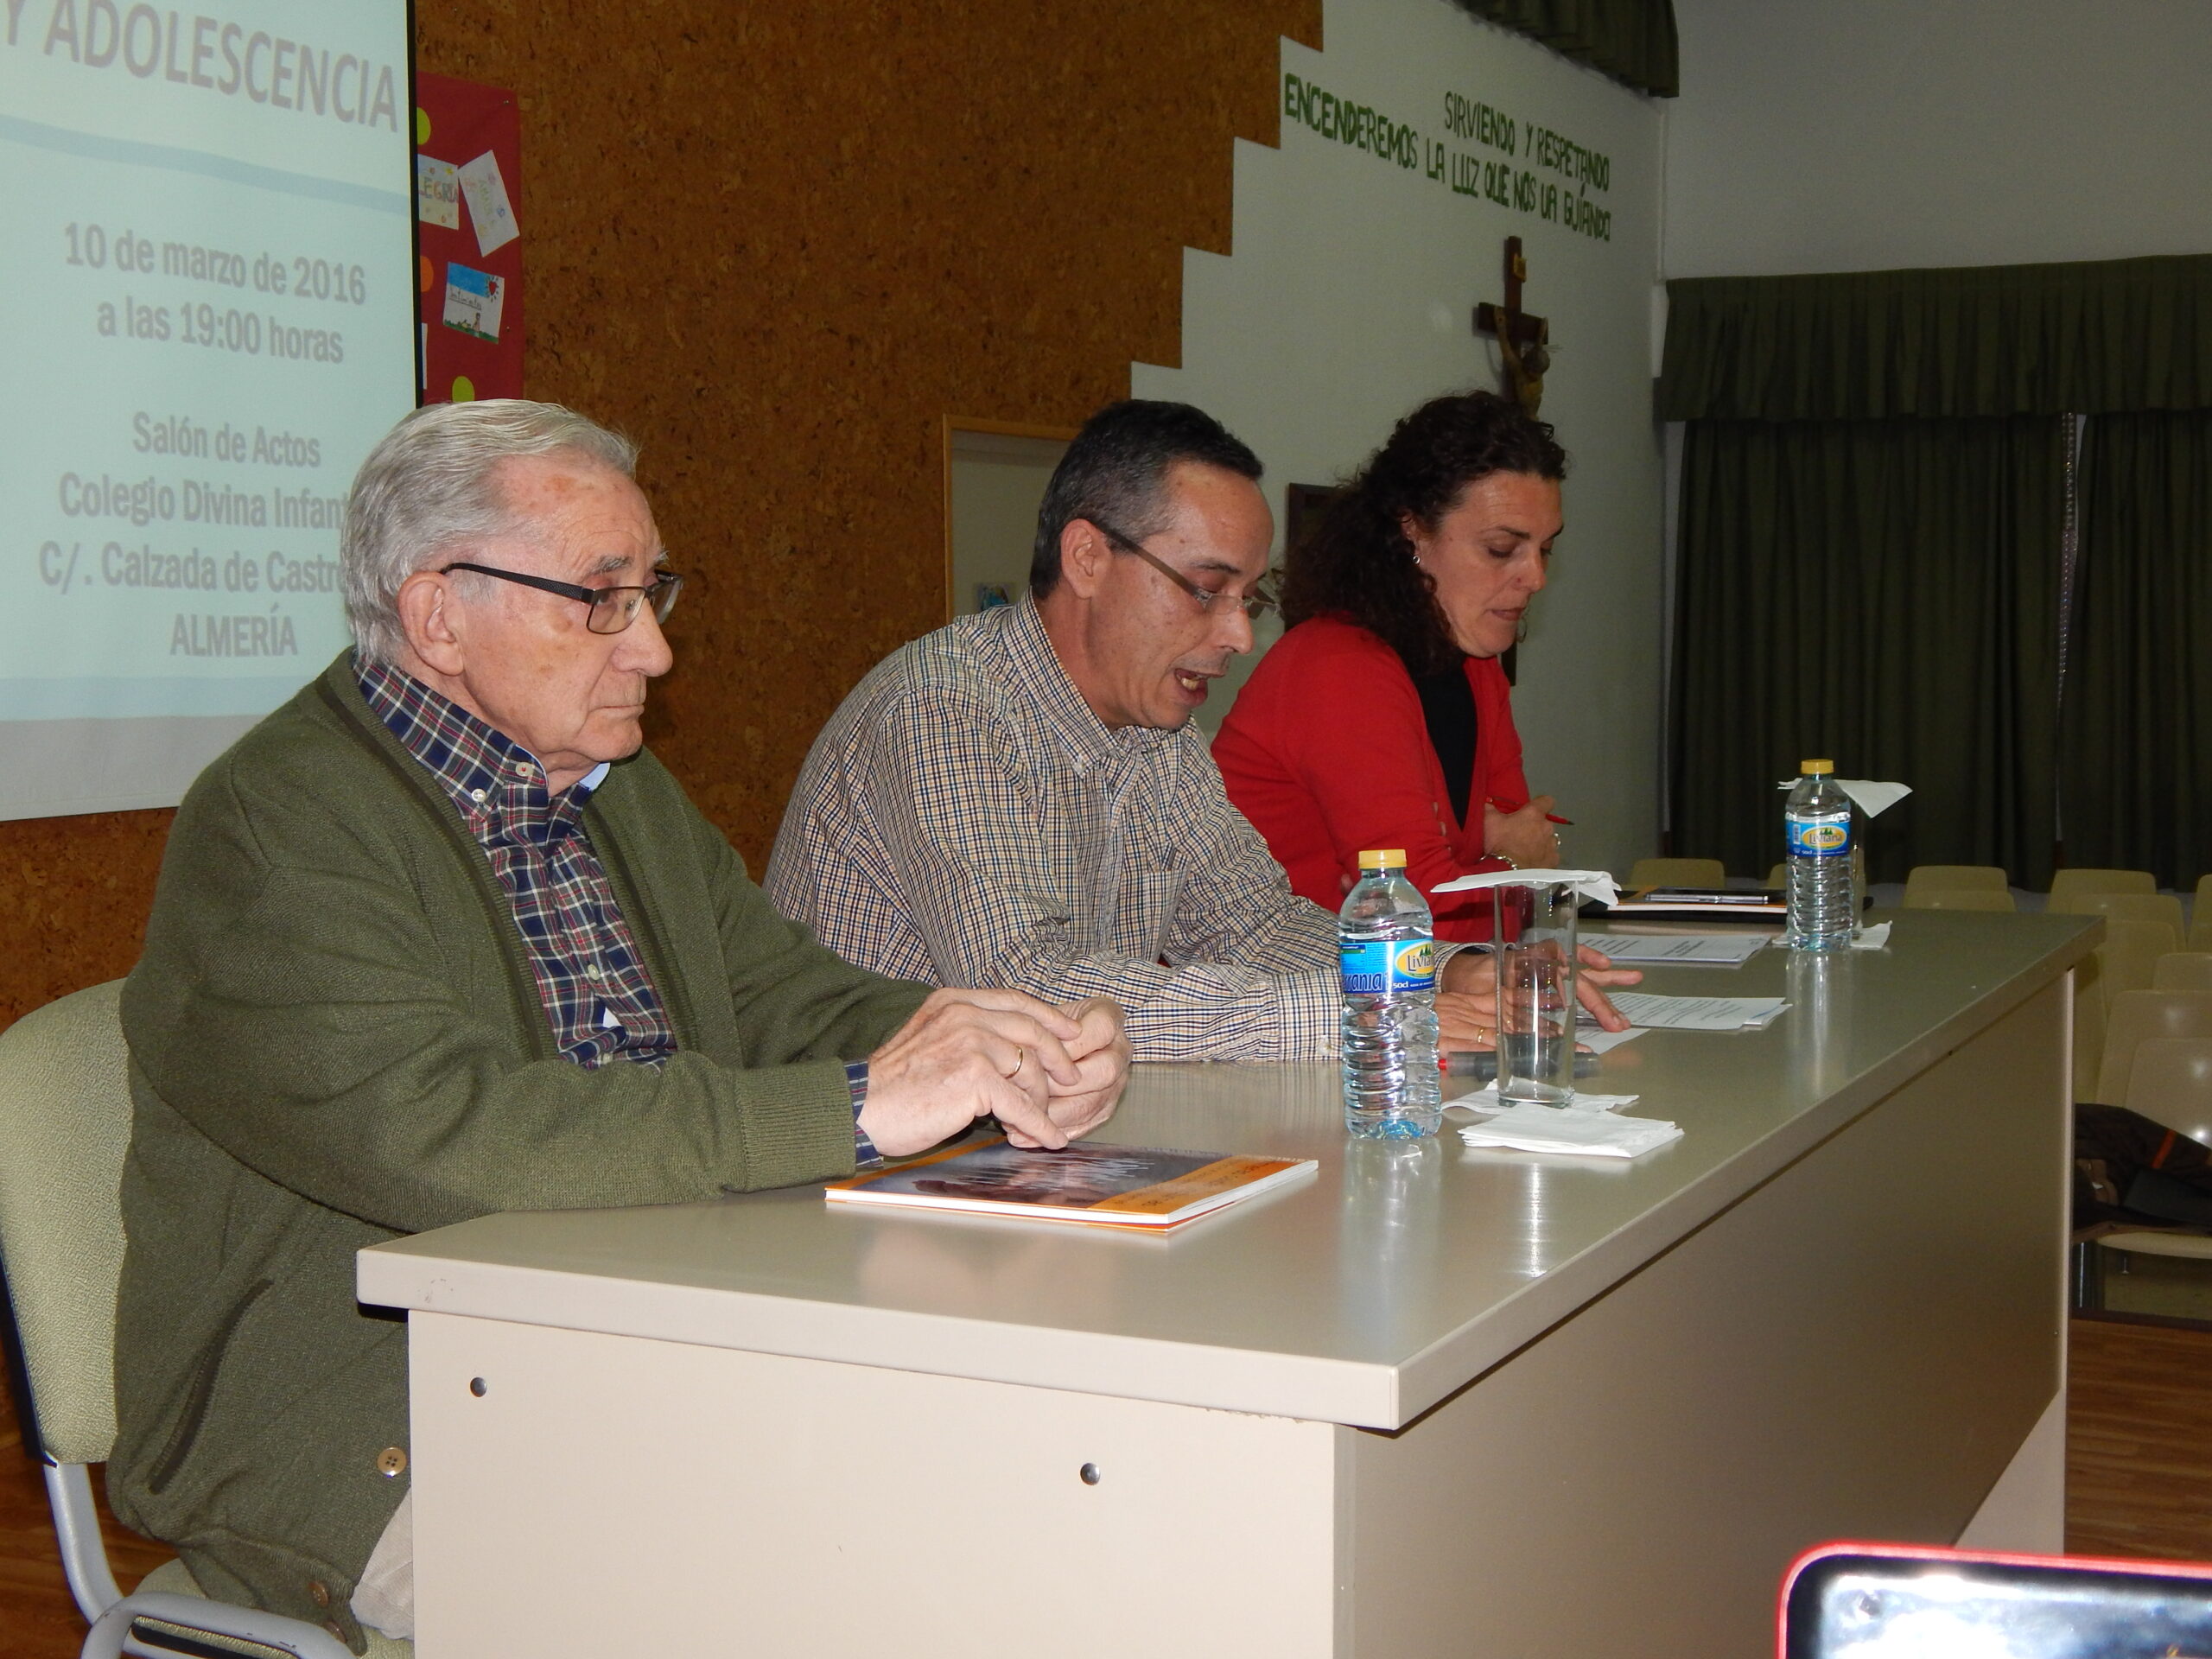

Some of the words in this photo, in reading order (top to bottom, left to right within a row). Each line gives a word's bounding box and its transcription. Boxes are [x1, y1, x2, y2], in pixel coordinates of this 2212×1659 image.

[7, 0, 25, 46] Y
[44, 0, 398, 133] ADOLESCENCIA
[1284, 73, 1418, 169] ENCENDEREMOS
[1426, 138, 1446, 183] LA
[1452, 153, 1480, 198] LUZ
[1484, 161, 1510, 207] QUE
[1513, 170, 1536, 213] NOS
[1444, 91, 1516, 156] SIRVIENDO
[1525, 121, 1534, 158] Y
[1537, 127, 1610, 192] RESPETANDO
[65, 222, 106, 270] 10
[115, 229, 155, 273] de
[162, 239, 246, 289] marzo
[253, 251, 287, 295] de
[294, 257, 366, 306] 2016
[97, 301, 116, 337] a
[125, 296, 171, 342] las
[181, 302, 260, 355] 19:00
[269, 316, 344, 364] horas
[132, 410, 208, 459] Salón
[215, 423, 246, 463] de
[252, 426, 321, 467] Actos
[59, 471, 174, 527] Colegio
[182, 479, 266, 527] Divina
[101, 541, 217, 591] Calzada
[224, 550, 259, 593] de
[169, 602, 298, 658] ALMERÍA
